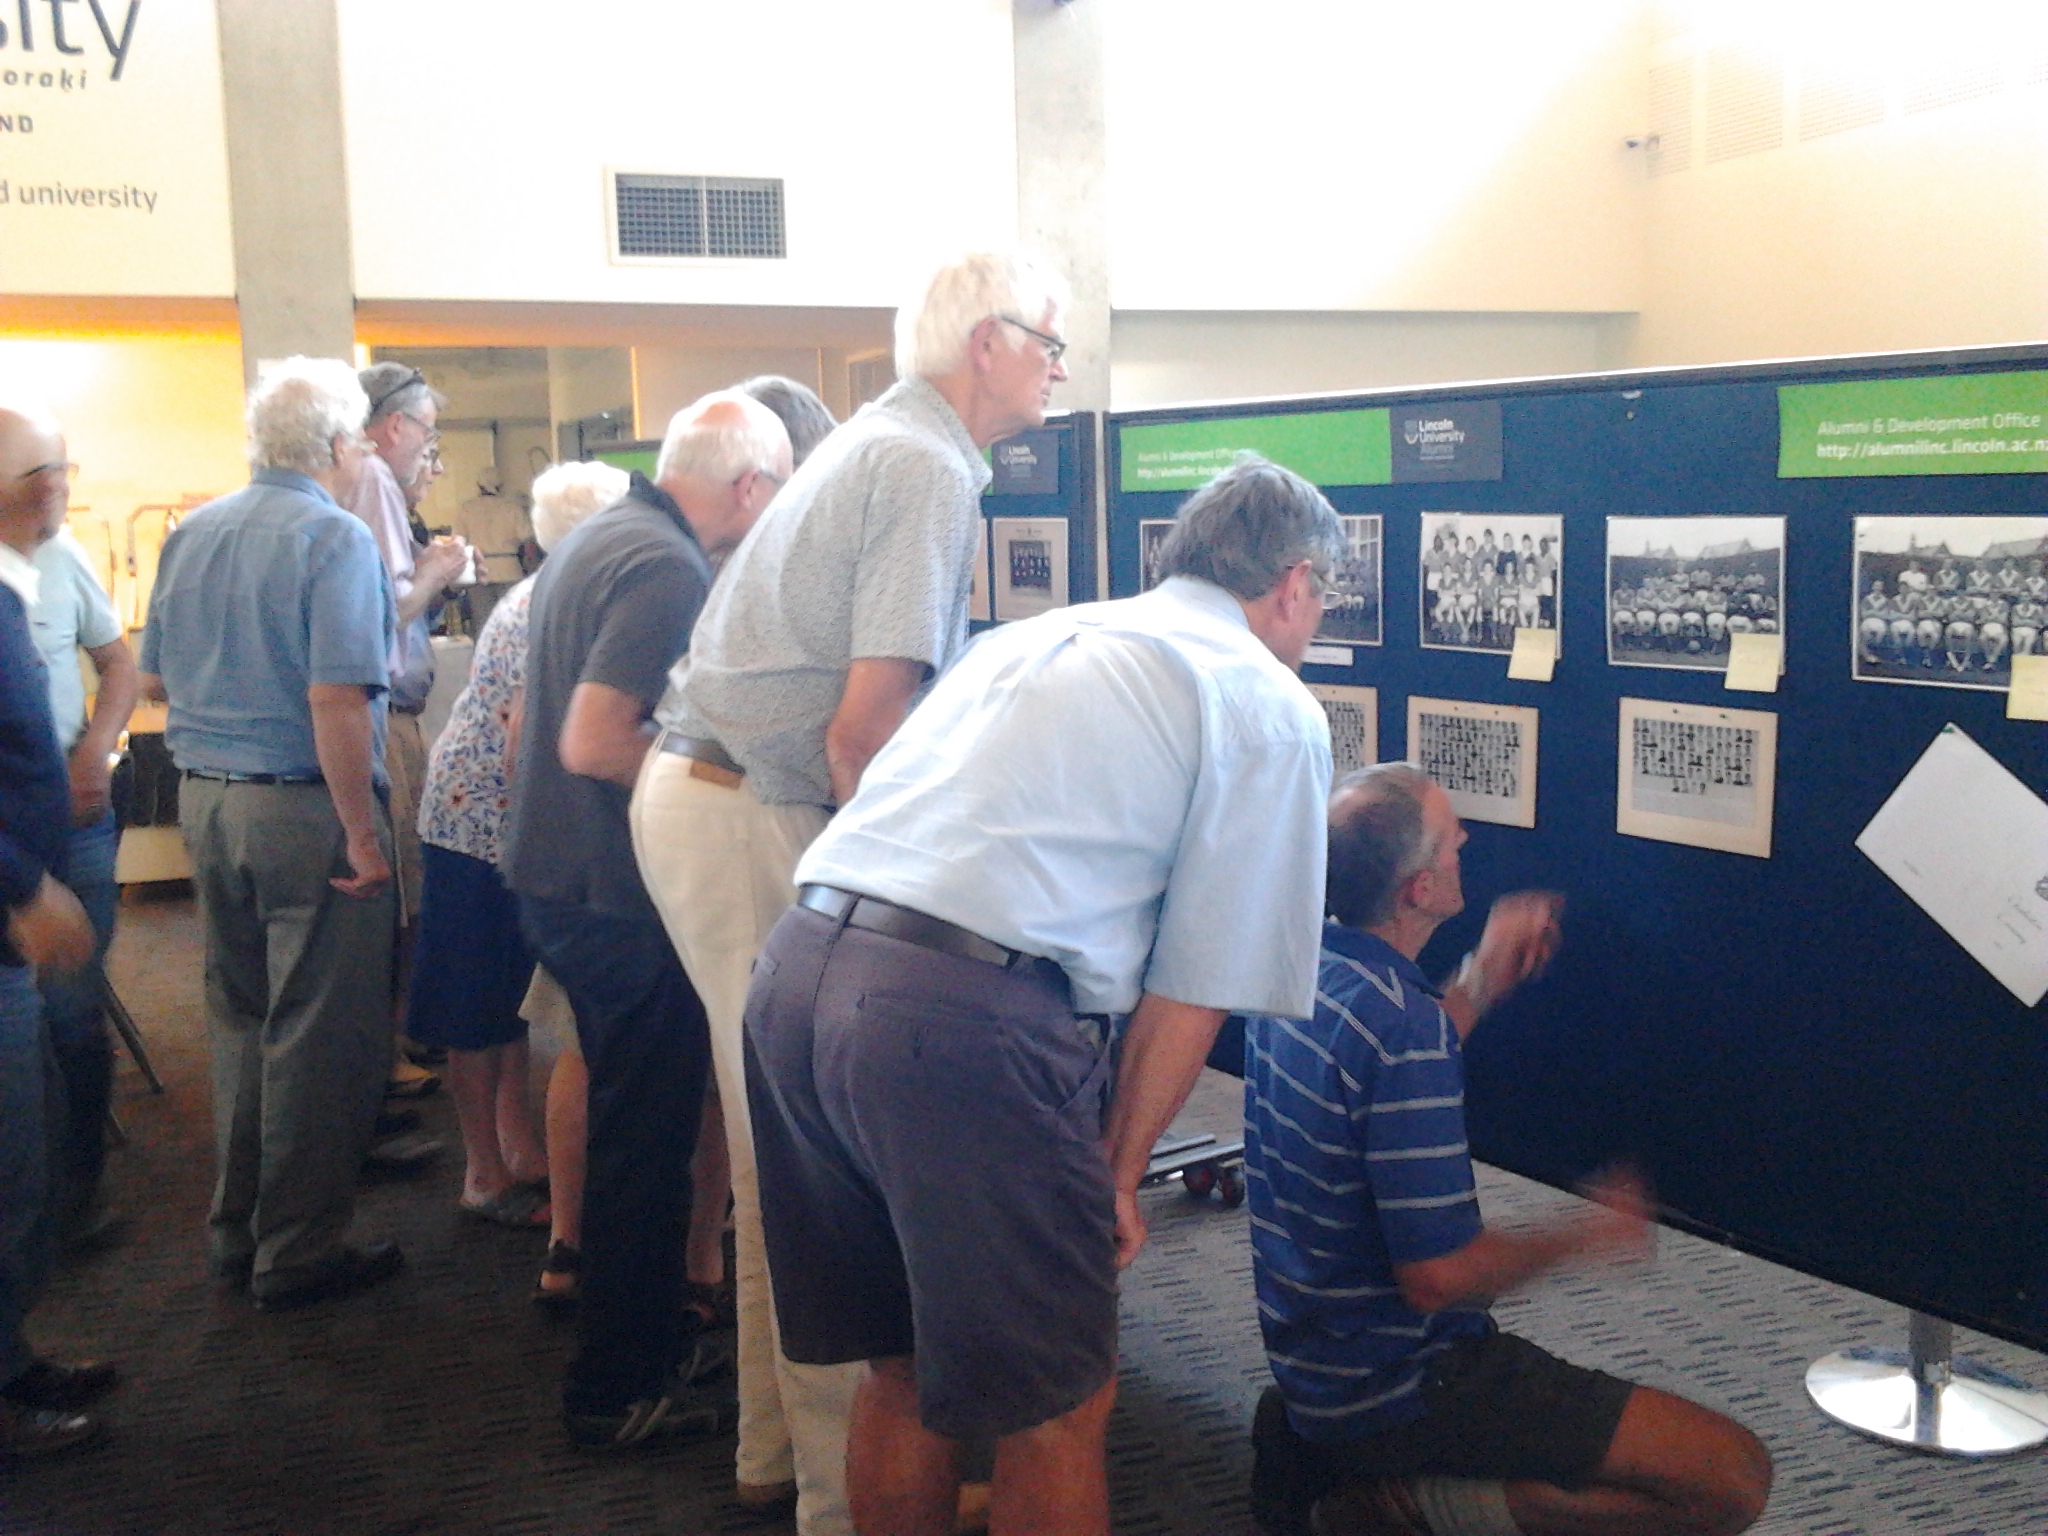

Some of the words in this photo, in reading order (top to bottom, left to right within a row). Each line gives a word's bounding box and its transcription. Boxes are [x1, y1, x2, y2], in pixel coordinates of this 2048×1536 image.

[19, 181, 158, 214] university
[1887, 415, 1989, 436] Development
[1992, 412, 2041, 430] Office
[1816, 437, 2048, 461] http://alumnilinc.lincoln.ac.n
